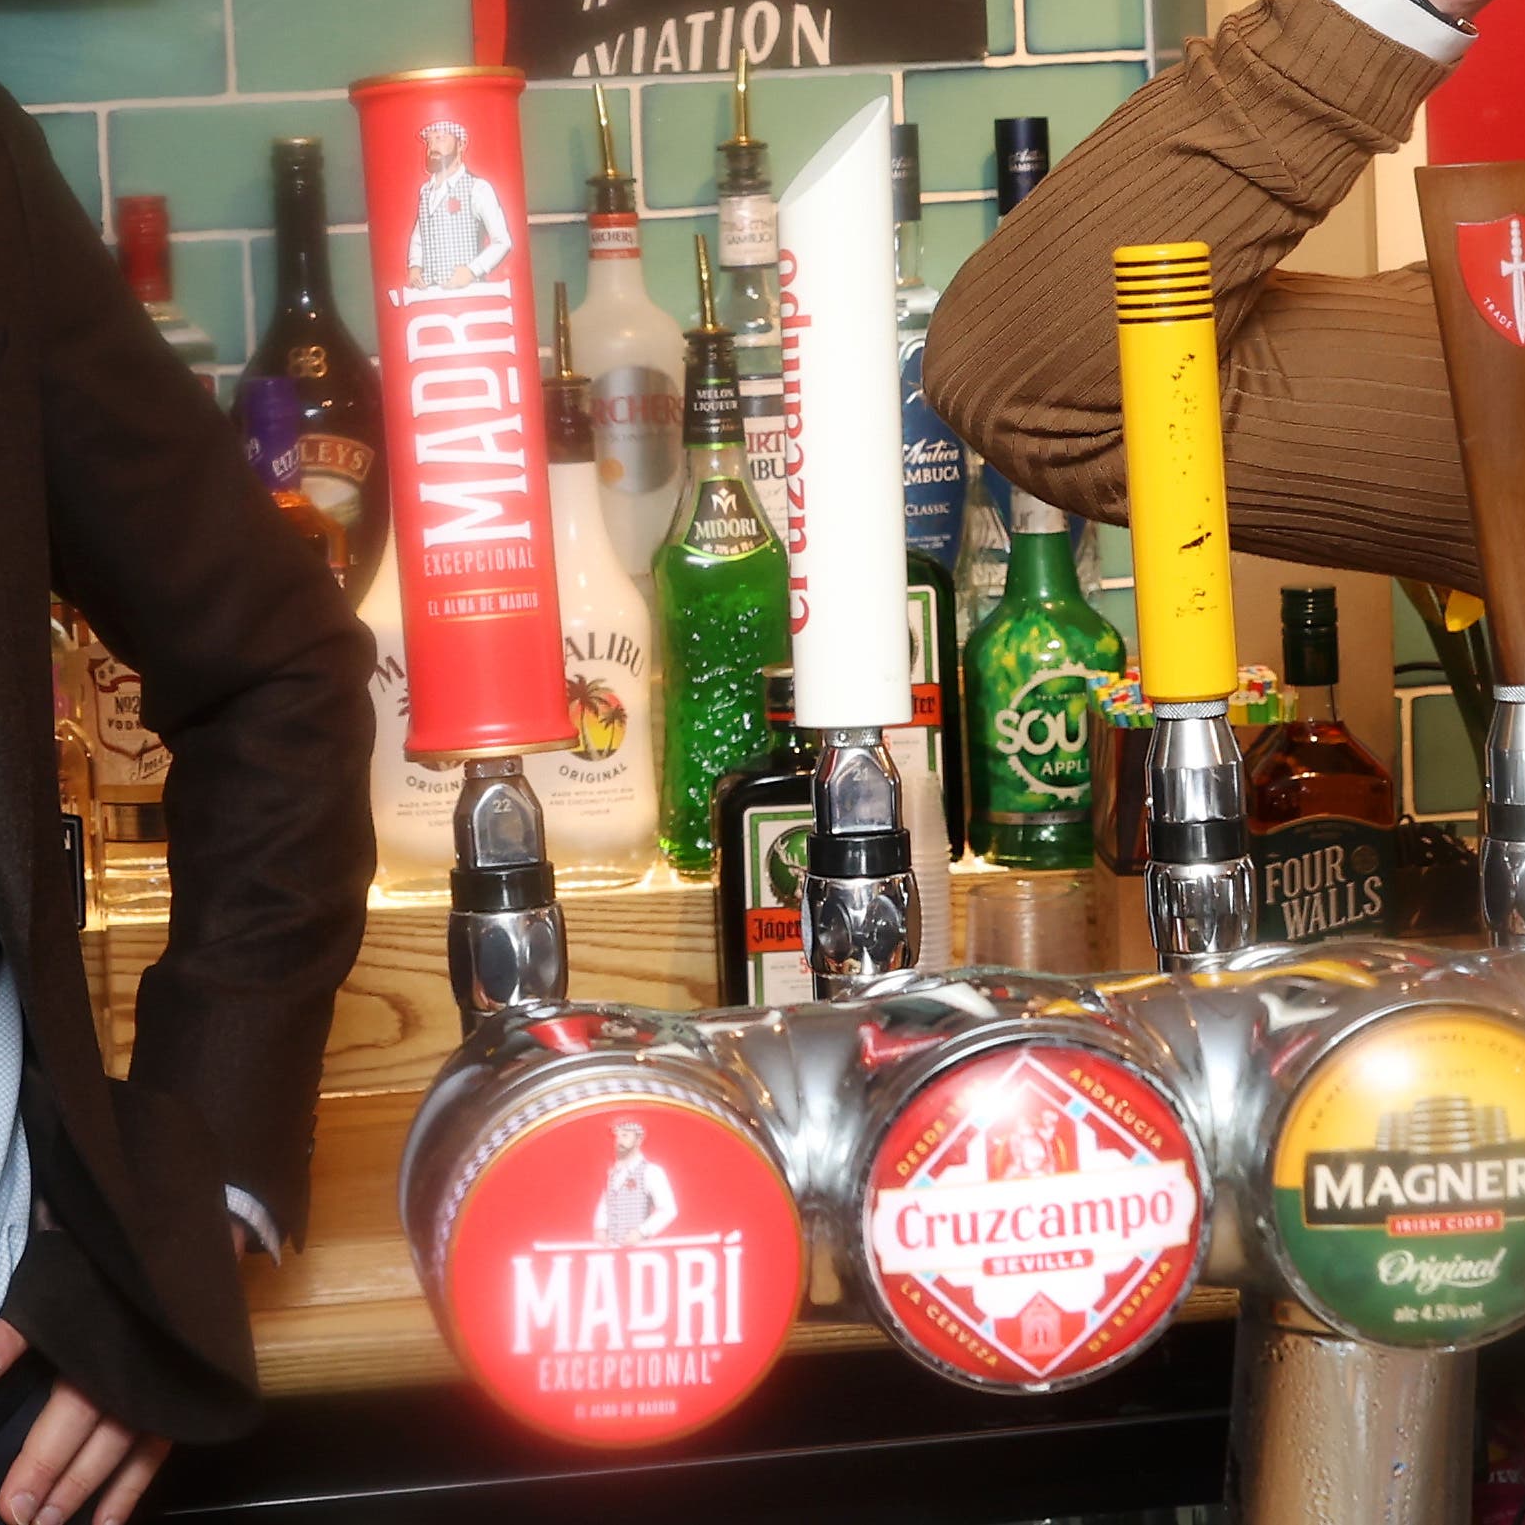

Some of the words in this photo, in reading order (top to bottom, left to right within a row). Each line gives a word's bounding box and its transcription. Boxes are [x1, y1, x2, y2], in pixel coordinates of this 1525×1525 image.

[573, 0, 832, 77] AVIATION
[1483, 295, 1513, 329] TRADE
[693, 399, 738, 412] LIQUEUR
[696, 388, 736, 400] MELON
[905, 503, 951, 517] CLASSIC
[695, 518, 757, 540] MIDORI
[424, 547, 535, 577] EXCEPCIONAL
[443, 598, 476, 614] ALMA
[479, 596, 494, 612] DE
[498, 593, 538, 611] MADRID
[995, 708, 1088, 755] SOU
[558, 764, 629, 785] ORIGINAL
[492, 799, 512, 813] 22
[1264, 845, 1347, 905] FOUR
[1281, 875, 1383, 940] WALLS
[895, 1188, 1174, 1250] Cruzcampo
[1395, 1218, 1441, 1233] IRISH
[1445, 1215, 1494, 1230] CIDER
[990, 1251, 1086, 1273] SEVILLA
[1378, 1246, 1507, 1296] Original
[511, 1228, 743, 1356] MADRÍ
[899, 1281, 922, 1306] LA
[538, 1354, 712, 1392] EXCEPCIONAL
